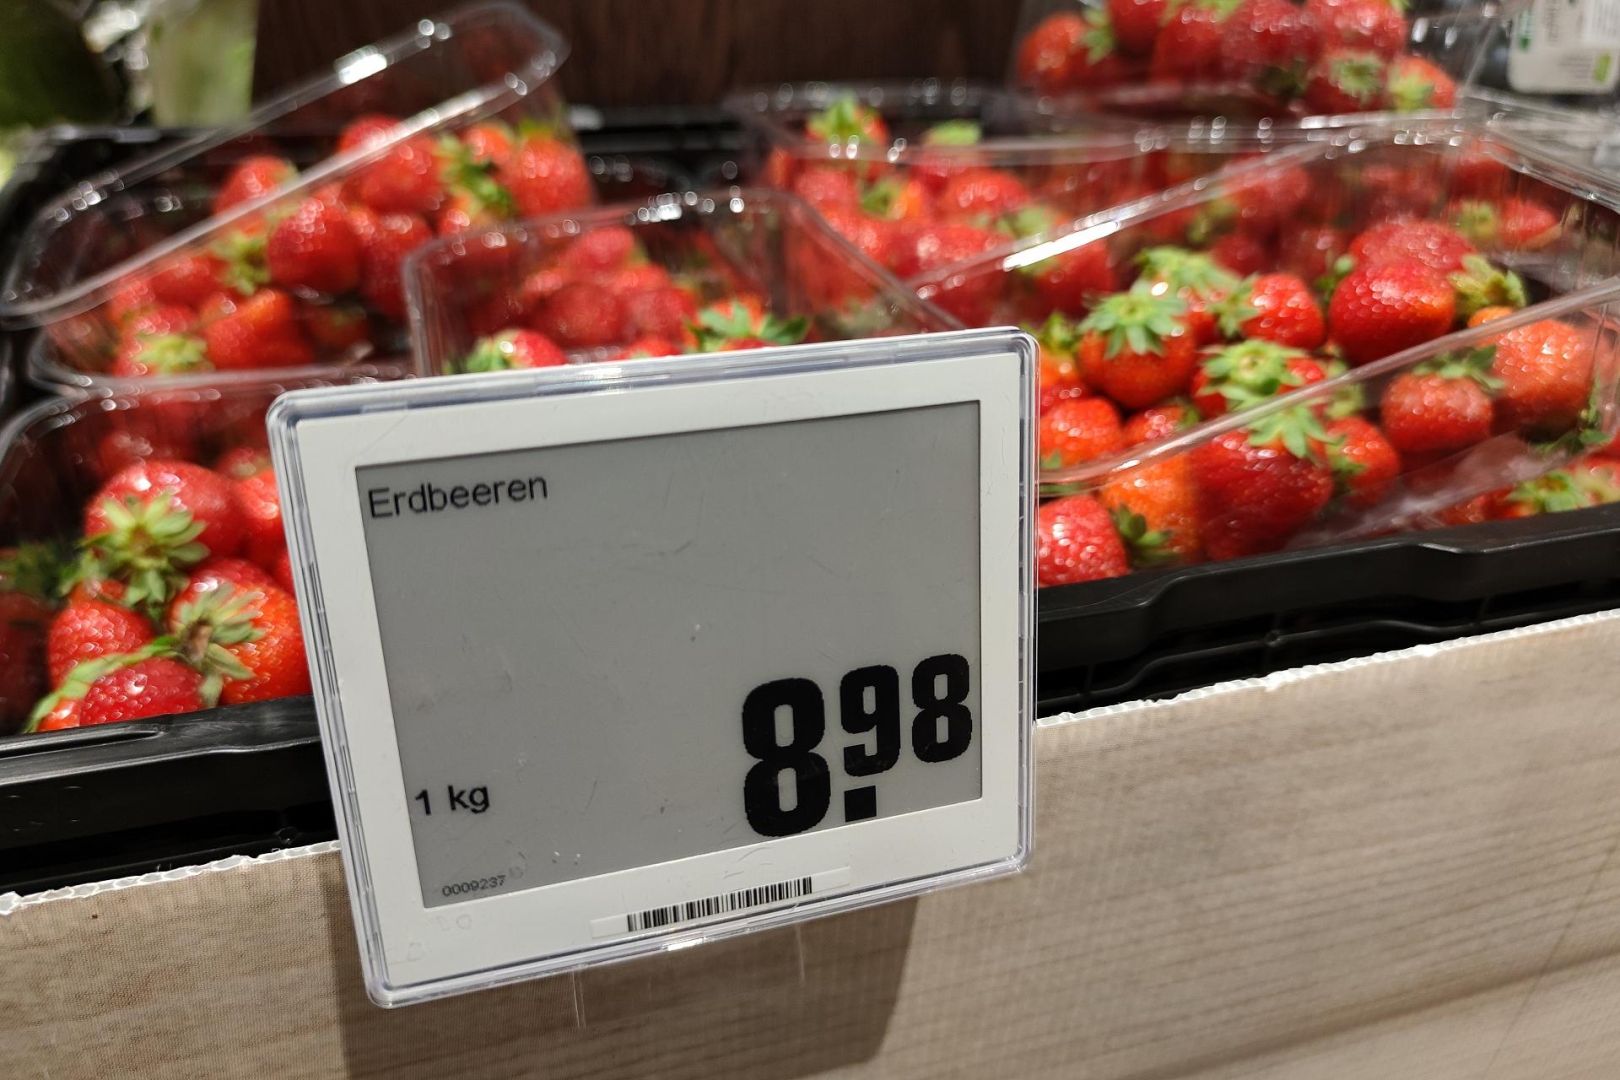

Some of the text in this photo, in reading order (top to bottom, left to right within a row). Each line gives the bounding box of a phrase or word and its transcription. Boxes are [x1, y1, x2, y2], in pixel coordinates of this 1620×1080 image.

[368, 475, 548, 519] Erdbeeren
[415, 784, 490, 816] 1 kg
[441, 874, 507, 897] 0009237
